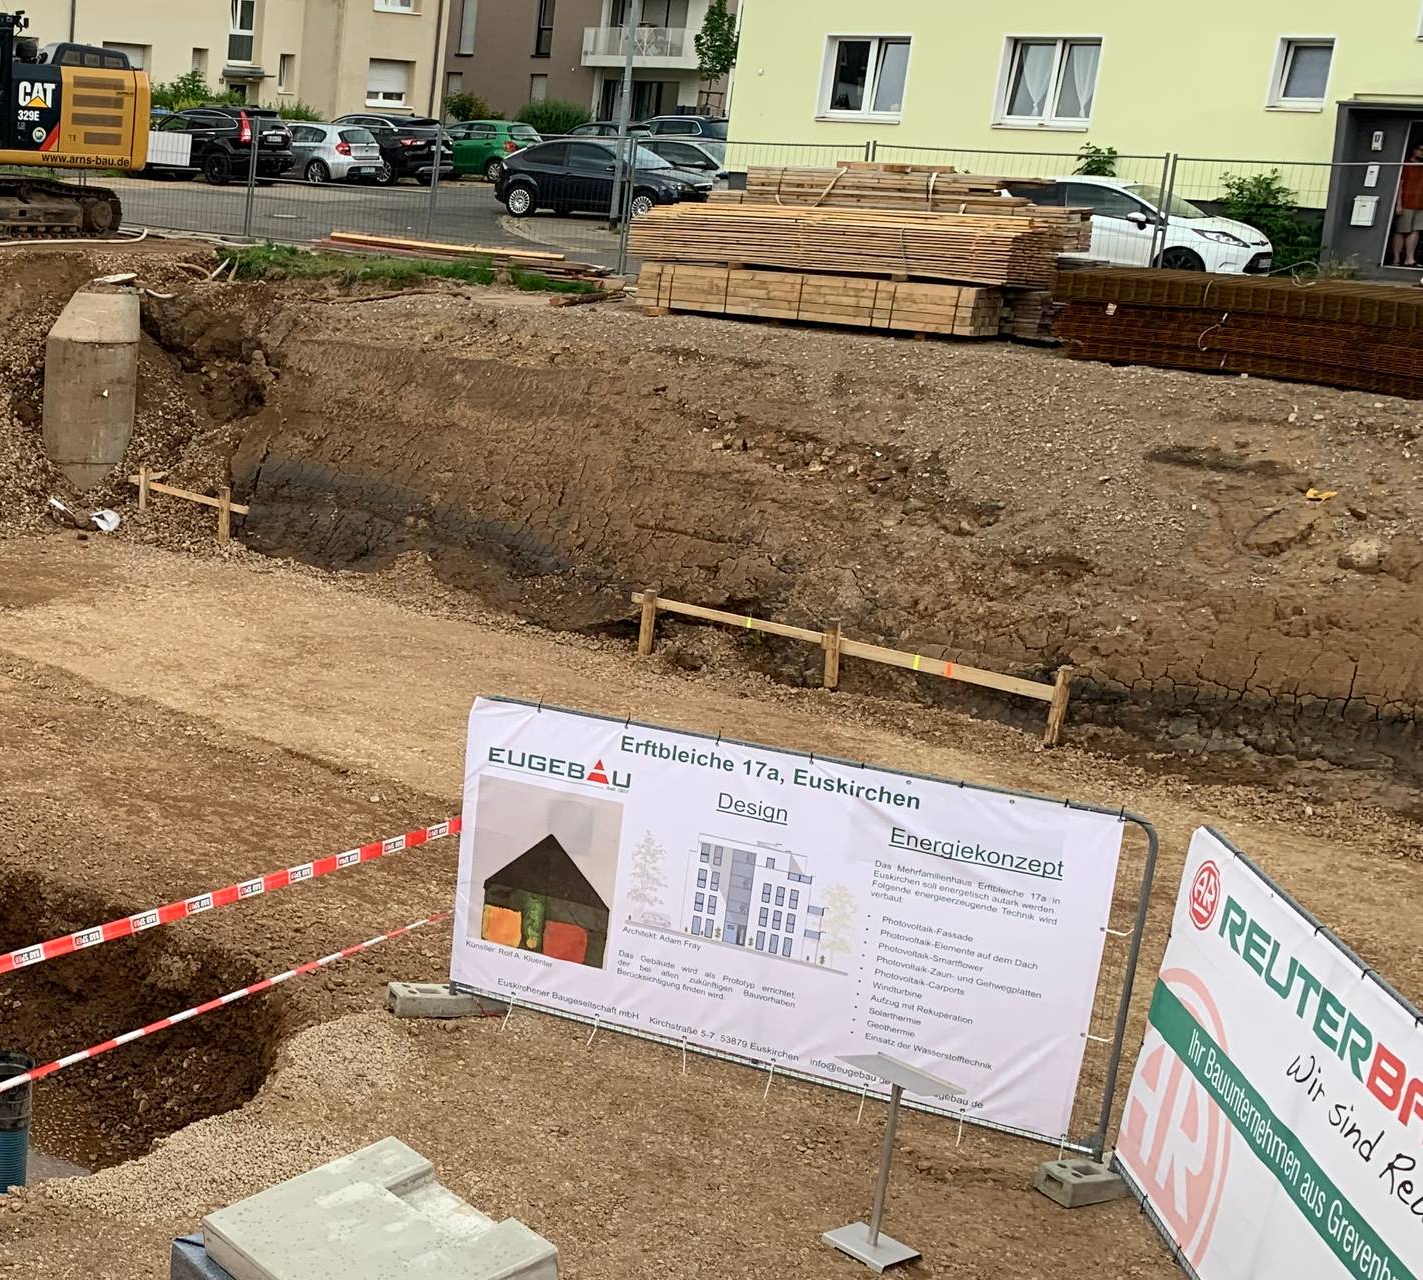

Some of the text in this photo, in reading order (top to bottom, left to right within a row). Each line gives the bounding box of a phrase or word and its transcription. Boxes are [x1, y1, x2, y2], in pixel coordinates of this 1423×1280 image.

[19, 81, 56, 108] CAT
[18, 110, 39, 121] 329E
[42, 154, 130, 168] www.arns-bau.de
[489, 747, 631, 789] EUGEBAU
[620, 736, 920, 810] Erftbleiche 17a, Euskirchen
[718, 793, 788, 824] Design
[891, 827, 1064, 877] Energiekonzept
[874, 870, 920, 886] Euskirchen
[923, 881, 937, 889] soll
[939, 884, 994, 900] energetisch
[992, 896, 1019, 907] autark
[875, 860, 891, 870] Das
[897, 865, 972, 887] Mehrfamilienhaus
[978, 882, 1024, 897] Erftbleiche
[1031, 893, 1046, 902] 17a
[872, 880, 911, 896] Folgende
[1002, 908, 1035, 921] Technik
[1039, 916, 1058, 925] wird
[659, 935, 682, 945] Adam
[684, 940, 702, 951] Fray
[882, 915, 973, 942] Photovoltaik-Fassade
[880, 929, 1038, 970] Photovoltaik-Elemente auf dem Dach
[618, 959, 630, 967] der
[639, 965, 651, 973] bei
[661, 970, 679, 980] allen
[743, 990, 795, 1008] Bauvorhaben
[619, 949, 634, 958] Das
[641, 954, 675, 969] Gebäude
[682, 965, 698, 974] wird
[723, 975, 755, 989] Prototyp
[874, 968, 965, 996] Photovoltaik-Carports
[682, 983, 706, 995] finden
[873, 981, 922, 999] Windturbine
[957, 975, 974, 984] und
[976, 978, 1042, 999] Gehwegplatten
[497, 978, 549, 997] Euskirchener
[552, 991, 617, 1015] Baugesellschaft
[618, 1009, 639, 1020] mbH
[649, 1016, 698, 1035] Kirchstraße
[720, 1034, 748, 1048] 53879
[749, 1042, 799, 1061] Euskirchen
[869, 1008, 922, 1025] Solarthermie
[871, 995, 973, 1024] Aufzug mit Rekuperation
[867, 1020, 915, 1037] Geothermie
[865, 1032, 993, 1070] Einsatz der Wasserstofftechnik
[1286, 1055, 1326, 1101] Wir
[1329, 1104, 1385, 1162] sind
[1188, 1029, 1398, 1280] Ihr Bauunternehmen aus Grevenb
